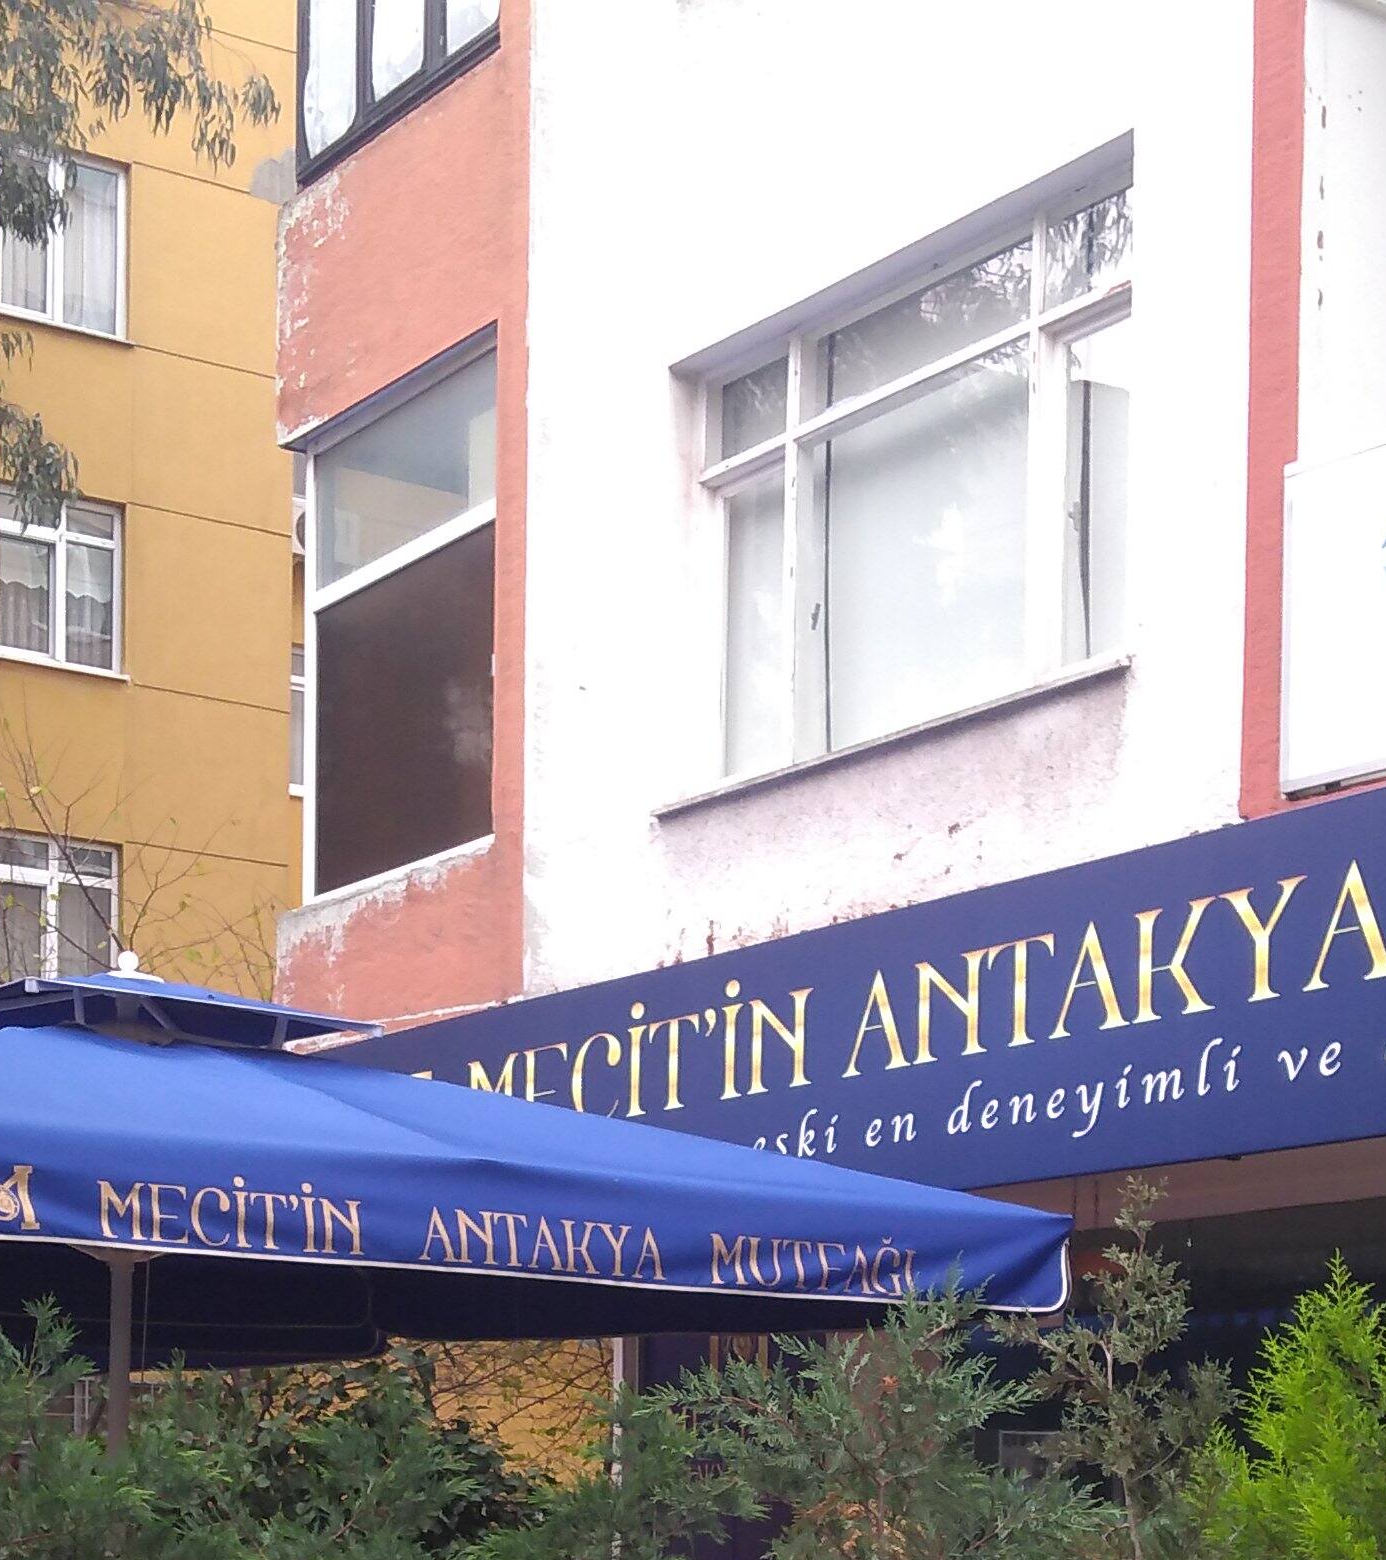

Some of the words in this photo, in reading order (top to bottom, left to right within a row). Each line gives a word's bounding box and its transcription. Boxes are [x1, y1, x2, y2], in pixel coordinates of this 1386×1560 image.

[865, 1112, 918, 1148] en
[946, 1037, 1241, 1138] deneyimli
[1277, 1039, 1343, 1083] ve
[96, 1175, 365, 1256] MECİT'İN
[418, 1205, 666, 1281] ANTAKYA
[709, 1235, 917, 1297] MUTFAĞI
